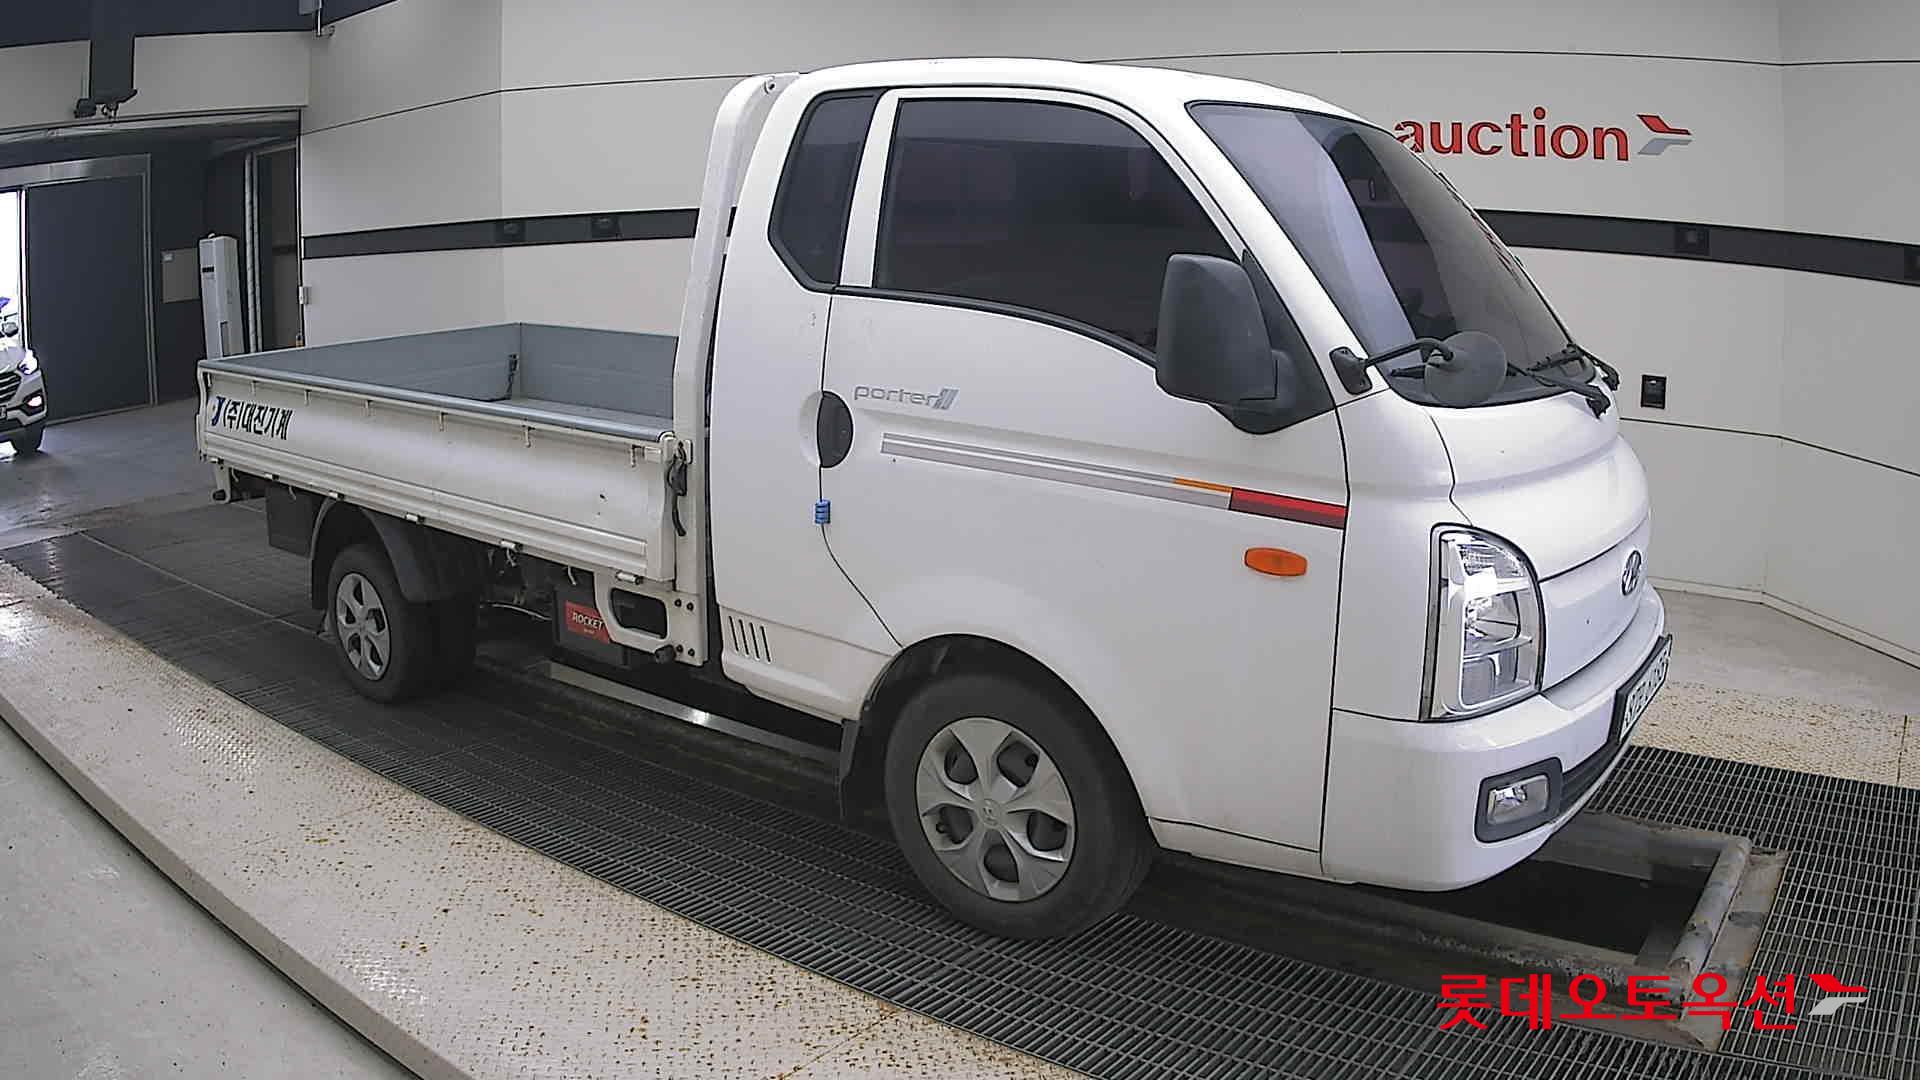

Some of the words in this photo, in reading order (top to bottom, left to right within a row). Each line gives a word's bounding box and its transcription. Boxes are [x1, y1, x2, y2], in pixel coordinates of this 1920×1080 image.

[1394, 106, 1629, 161] auction
[854, 386, 941, 406] porter
[572, 611, 604, 630] ROCKET
